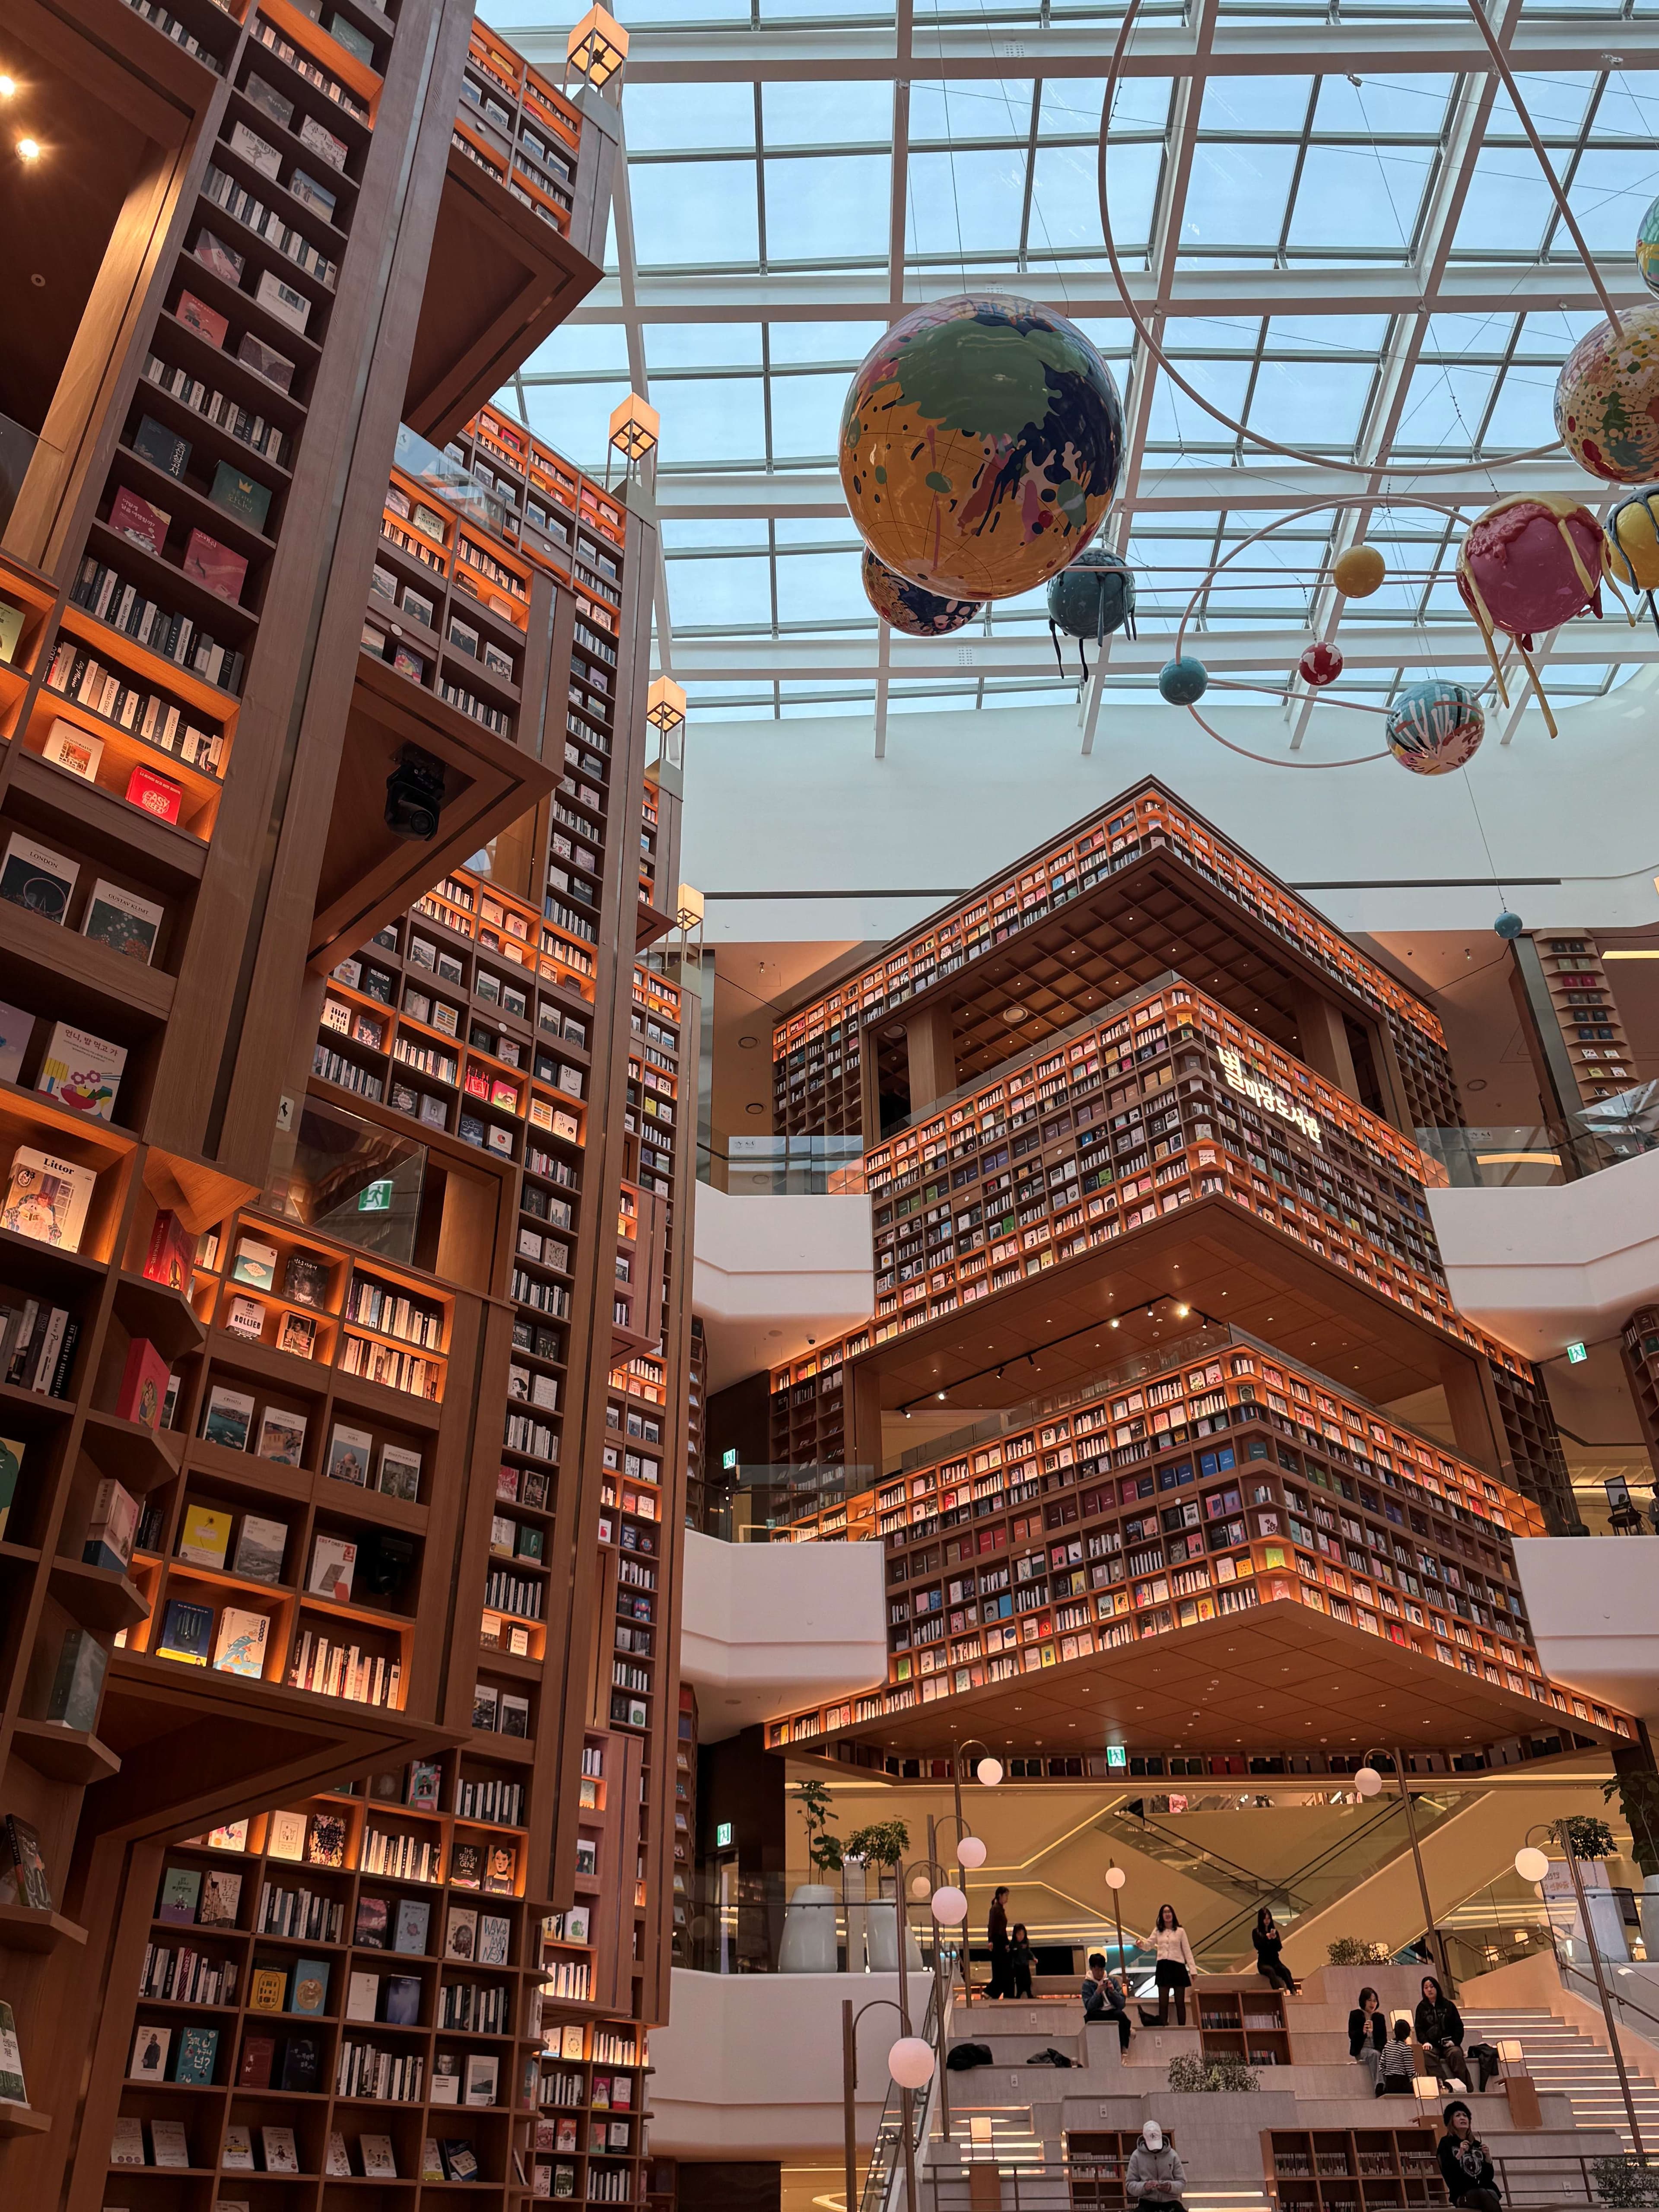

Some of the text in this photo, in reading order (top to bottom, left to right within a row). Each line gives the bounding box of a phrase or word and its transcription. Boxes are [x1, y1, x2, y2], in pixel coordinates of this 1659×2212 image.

[242, 127, 256, 140] 나는
[169, 441, 185, 476] 조선상고사
[143, 791, 169, 808] EASY
[30, 852, 58, 868] LONDON
[108, 893, 149, 915] GUSTAV KLIMT
[66, 1030, 81, 1042] 언니,
[85, 1037, 92, 1046] 밥
[94, 1041, 108, 1052] 먹고
[1216, 1046, 1321, 1144] 별마당도서관
[44, 1158, 74, 1175] Littor
[224, 1396, 242, 1405] CROATIA
[460, 1860, 475, 1869] GENE
[194, 2056, 211, 2069] 넌?
